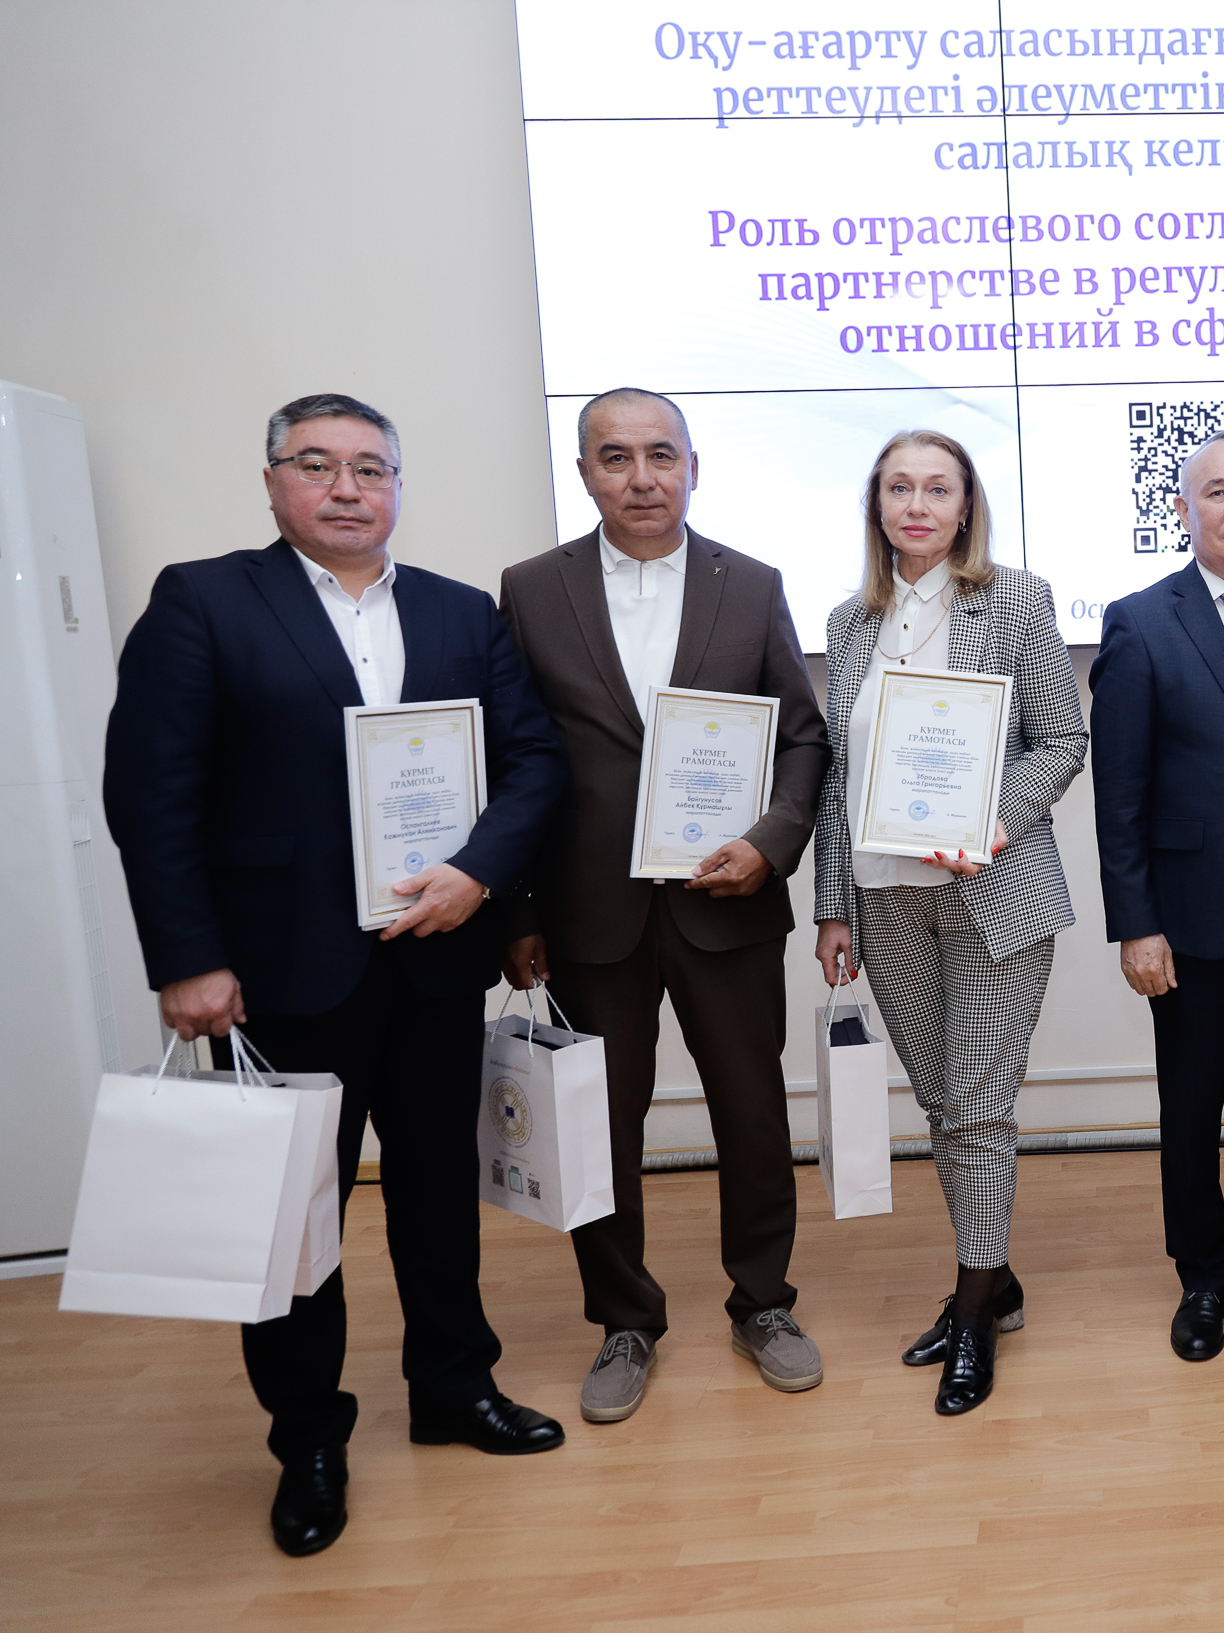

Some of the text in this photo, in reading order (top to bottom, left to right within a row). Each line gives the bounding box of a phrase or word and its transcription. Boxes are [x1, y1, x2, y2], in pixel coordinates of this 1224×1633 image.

[655, 22, 928, 71] Оқу-ағарту
[713, 74, 964, 128] реттеудегі
[934, 137, 1133, 176] салалық
[708, 210, 821, 247] Роль
[832, 208, 1122, 256] отраслевого
[758, 267, 1060, 311] партнерстве
[1074, 268, 1099, 296] в
[839, 308, 1121, 354] отношений
[1135, 319, 1160, 347] в
[681, 757, 736, 767] ГРАМОТАСЫ
[908, 734, 966, 746] ГРАМОТАСЫ
[391, 776, 445, 789] ГРАМОТАСЫ
